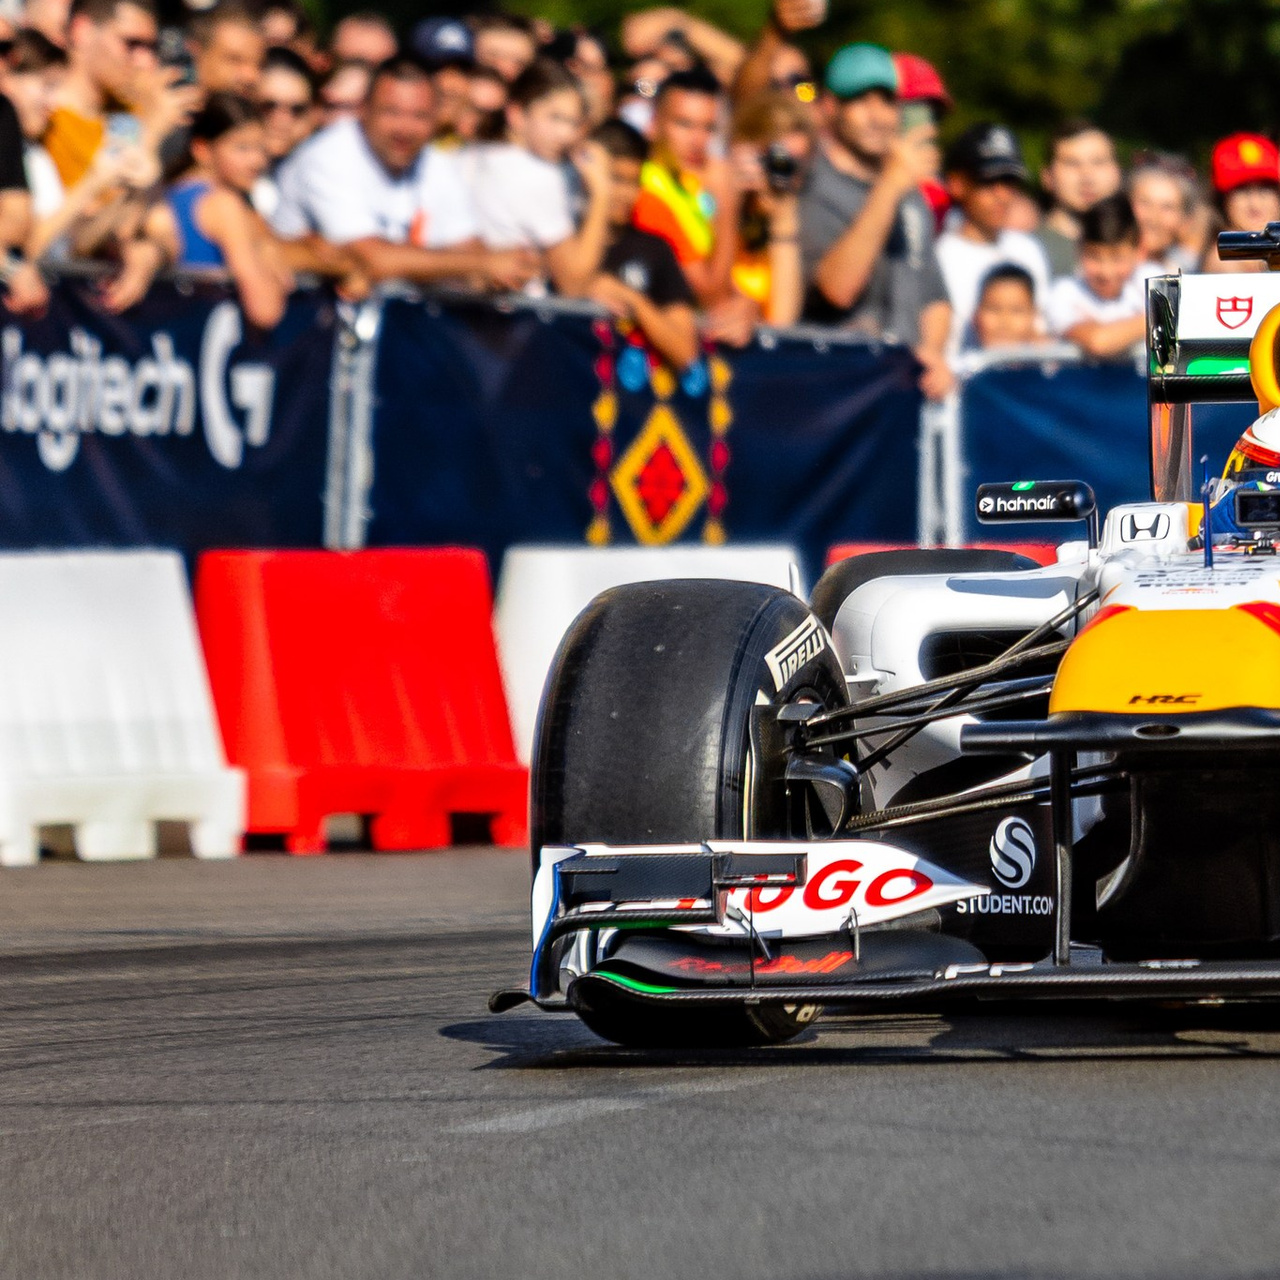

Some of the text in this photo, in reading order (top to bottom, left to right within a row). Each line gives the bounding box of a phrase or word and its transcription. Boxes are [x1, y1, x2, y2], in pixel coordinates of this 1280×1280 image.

[997, 494, 1056, 512] hahnair
[764, 613, 825, 692] PIRELLI
[1128, 694, 1203, 705] HRC
